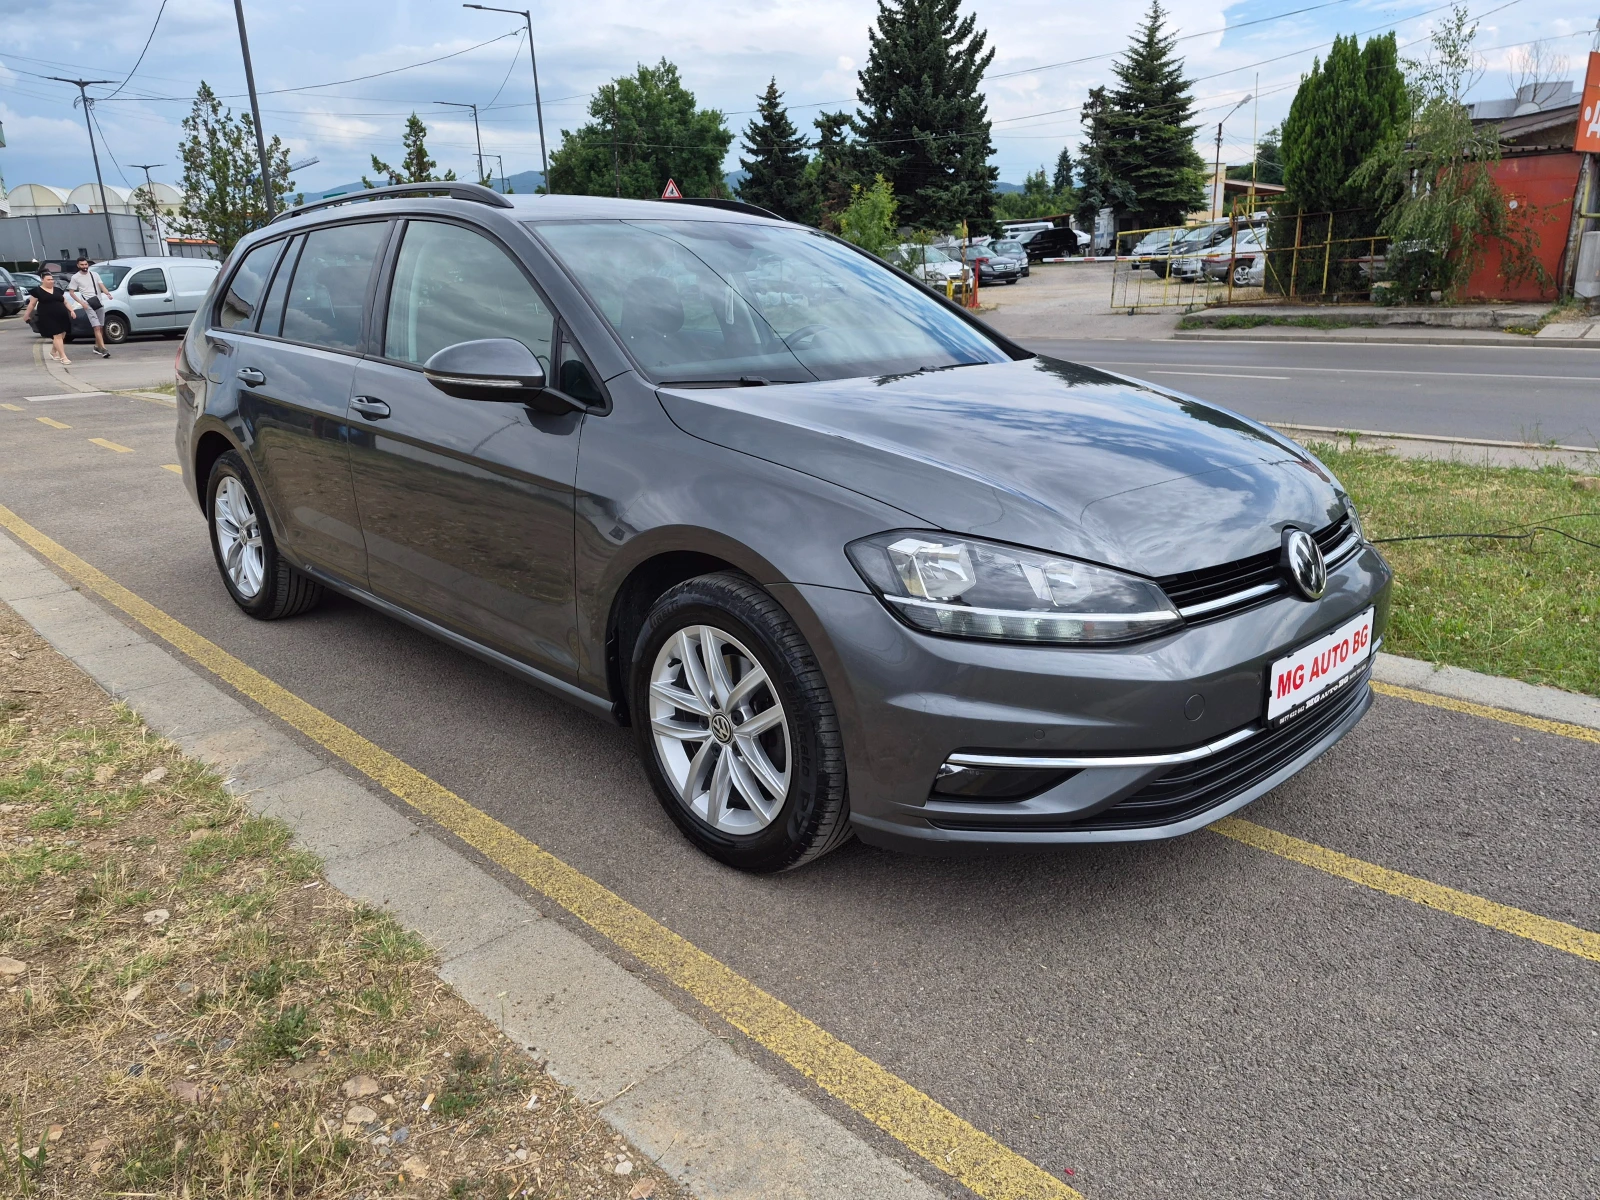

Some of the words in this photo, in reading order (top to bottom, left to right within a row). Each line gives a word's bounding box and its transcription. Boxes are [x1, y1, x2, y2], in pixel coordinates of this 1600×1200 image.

[1277, 663, 1305, 700] MG
[1309, 638, 1349, 684] AUTO
[1352, 624, 1369, 655] BG
